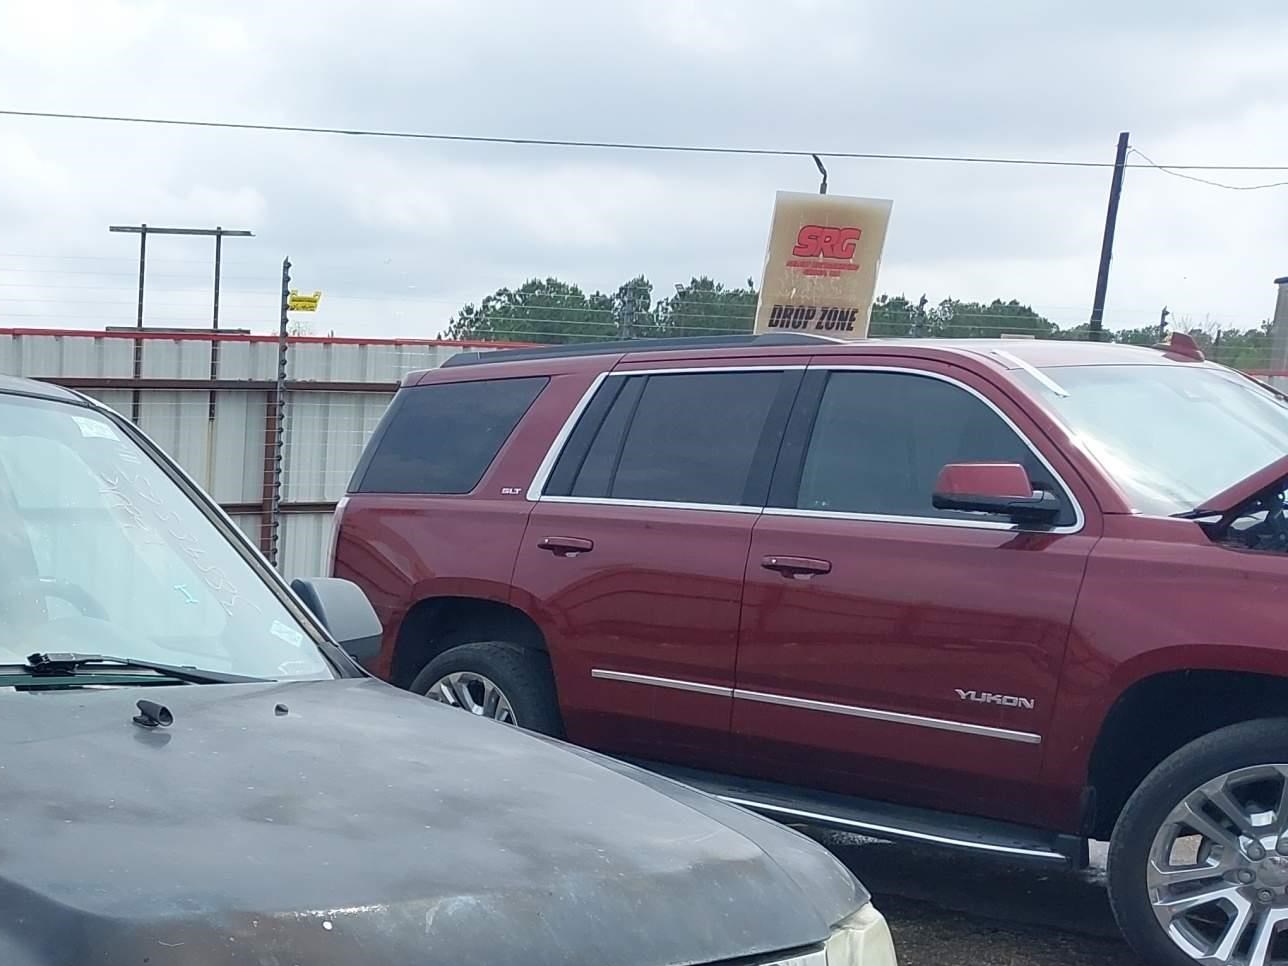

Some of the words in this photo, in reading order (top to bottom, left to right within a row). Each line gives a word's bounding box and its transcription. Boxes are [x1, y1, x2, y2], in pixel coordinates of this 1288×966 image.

[792, 225, 861, 259] SRG
[768, 304, 817, 330] DROP
[815, 306, 859, 332] ZONE
[954, 688, 1035, 710] YUKON
